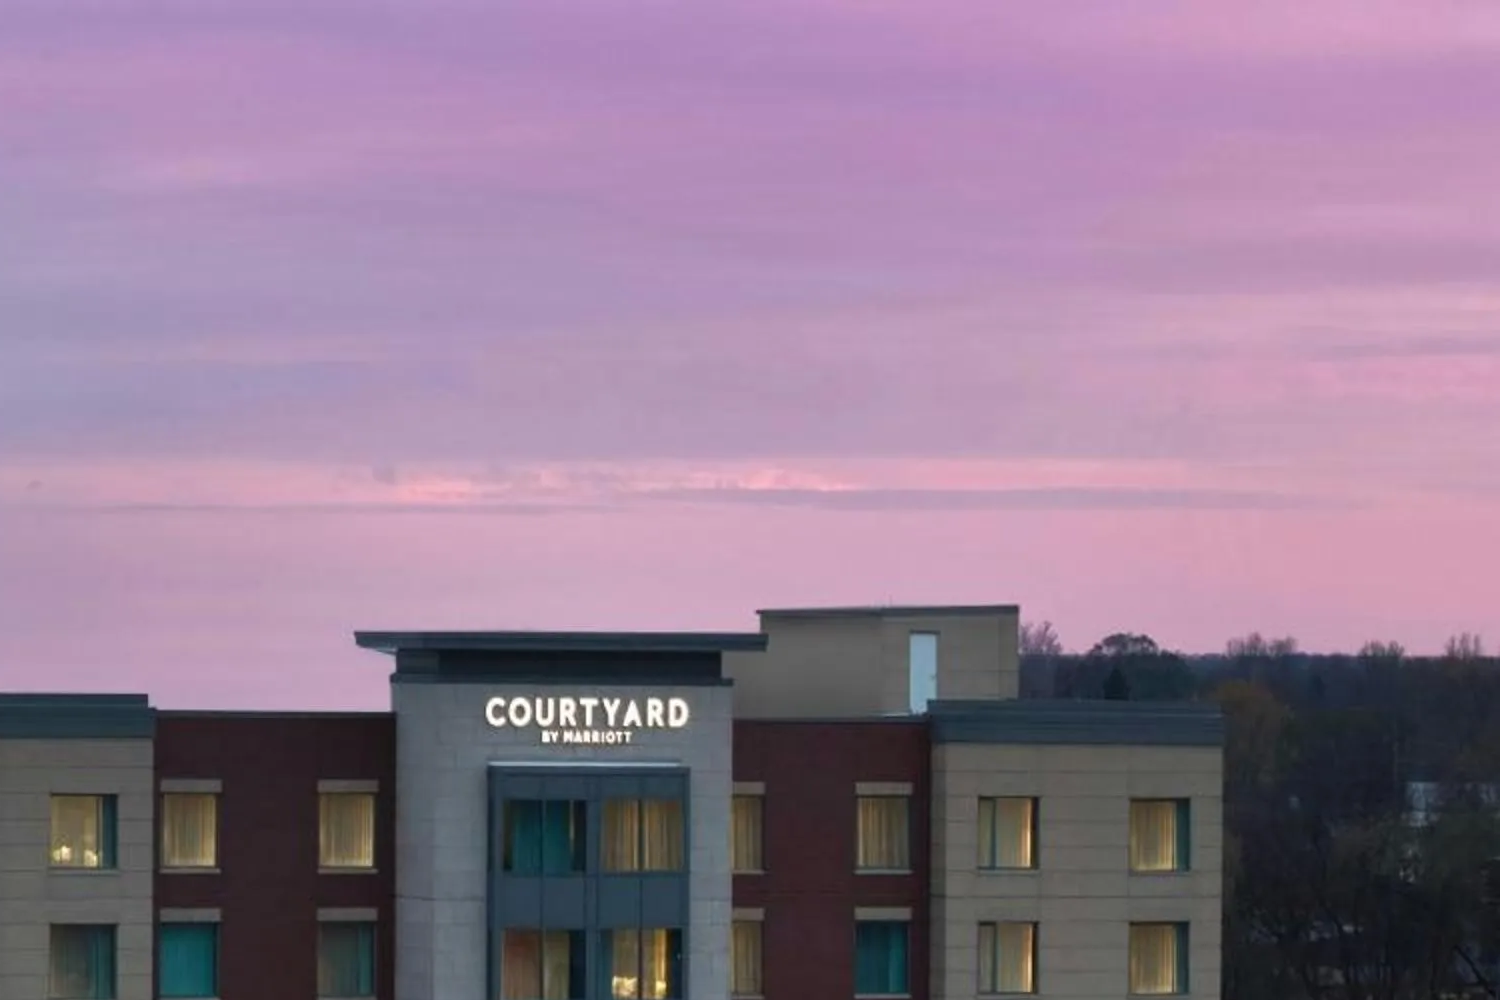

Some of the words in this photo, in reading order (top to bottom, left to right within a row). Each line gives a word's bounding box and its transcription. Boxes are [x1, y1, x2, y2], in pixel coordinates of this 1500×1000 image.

[485, 697, 689, 727] COURTYARD
[541, 730, 558, 743] BY
[563, 730, 632, 743] MARRIOTT
